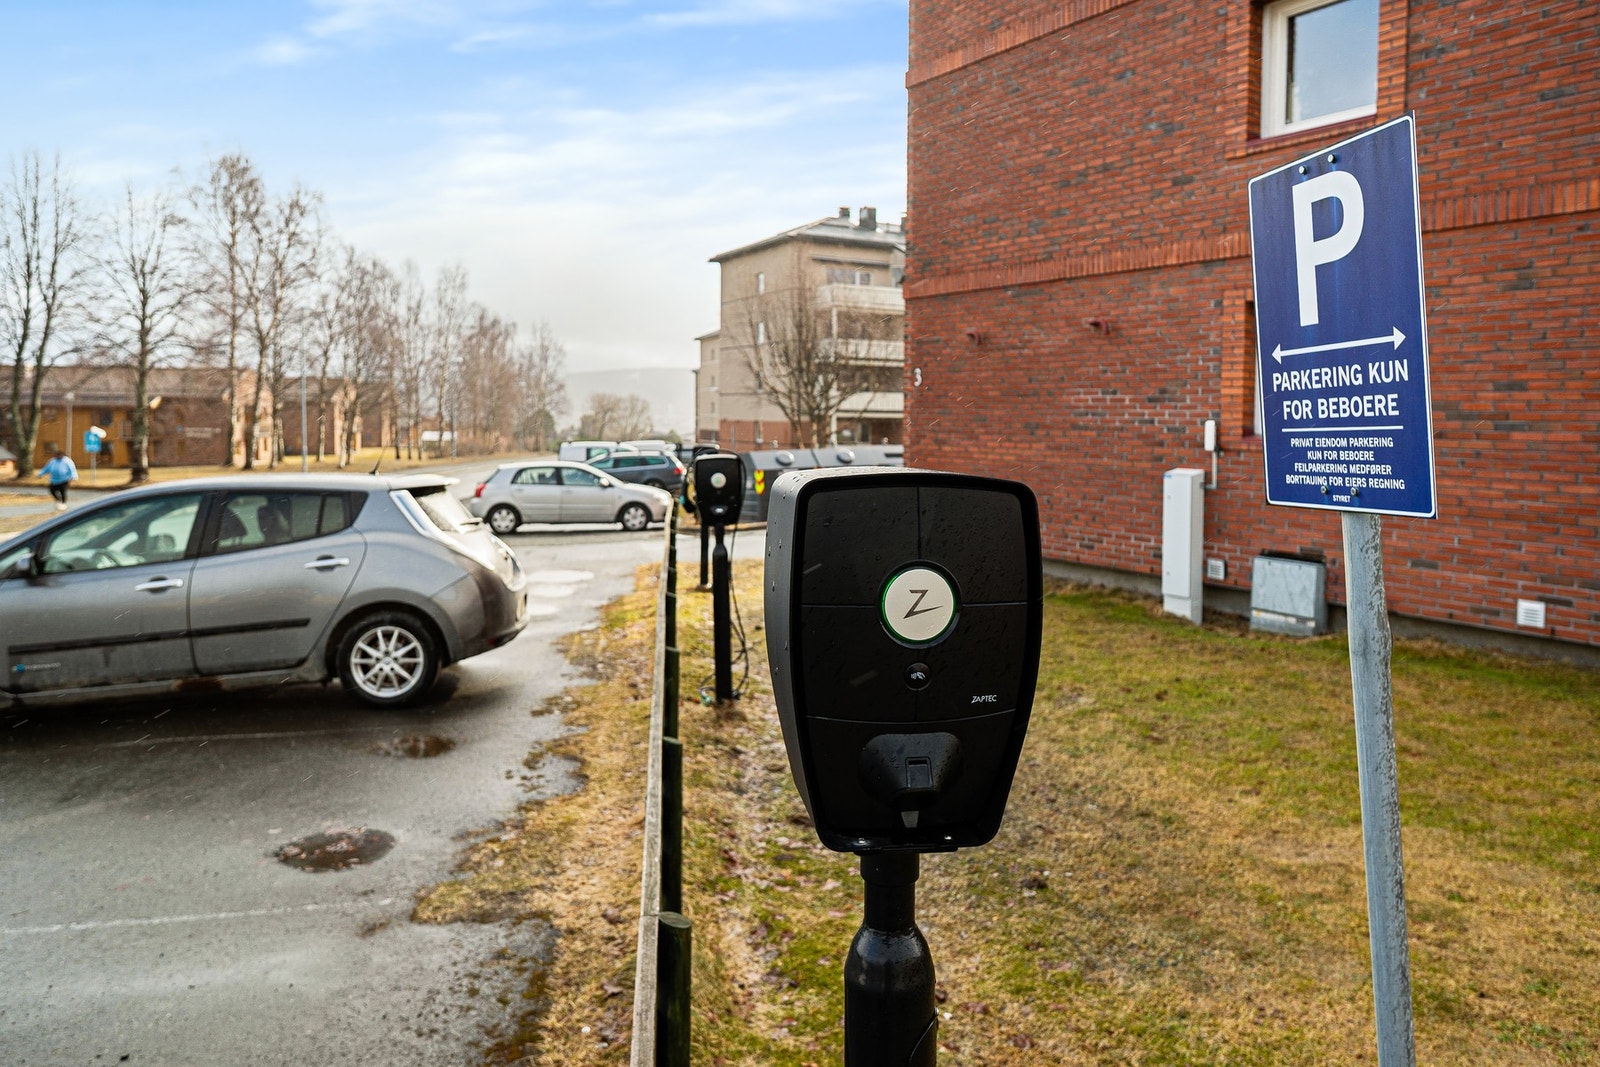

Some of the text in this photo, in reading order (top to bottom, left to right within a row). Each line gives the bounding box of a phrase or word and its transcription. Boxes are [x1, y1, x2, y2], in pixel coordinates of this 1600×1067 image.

[1292, 170, 1365, 327] P
[1272, 359, 1409, 392] PARKERING KUN
[1283, 393, 1400, 420] FOR BEBOERE
[1290, 436, 1394, 448] PRIVAT EIENDOM PARKERING
[1307, 450, 1375, 461] KUN FOR BEBOERE
[1294, 462, 1392, 475] FEILPARKERING MEDFØRER
[1285, 474, 1406, 490] BORTTAUING FOR EIERS REGNING
[1332, 494, 1351, 503] STYRET
[970, 694, 998, 704] ZAPTEC
